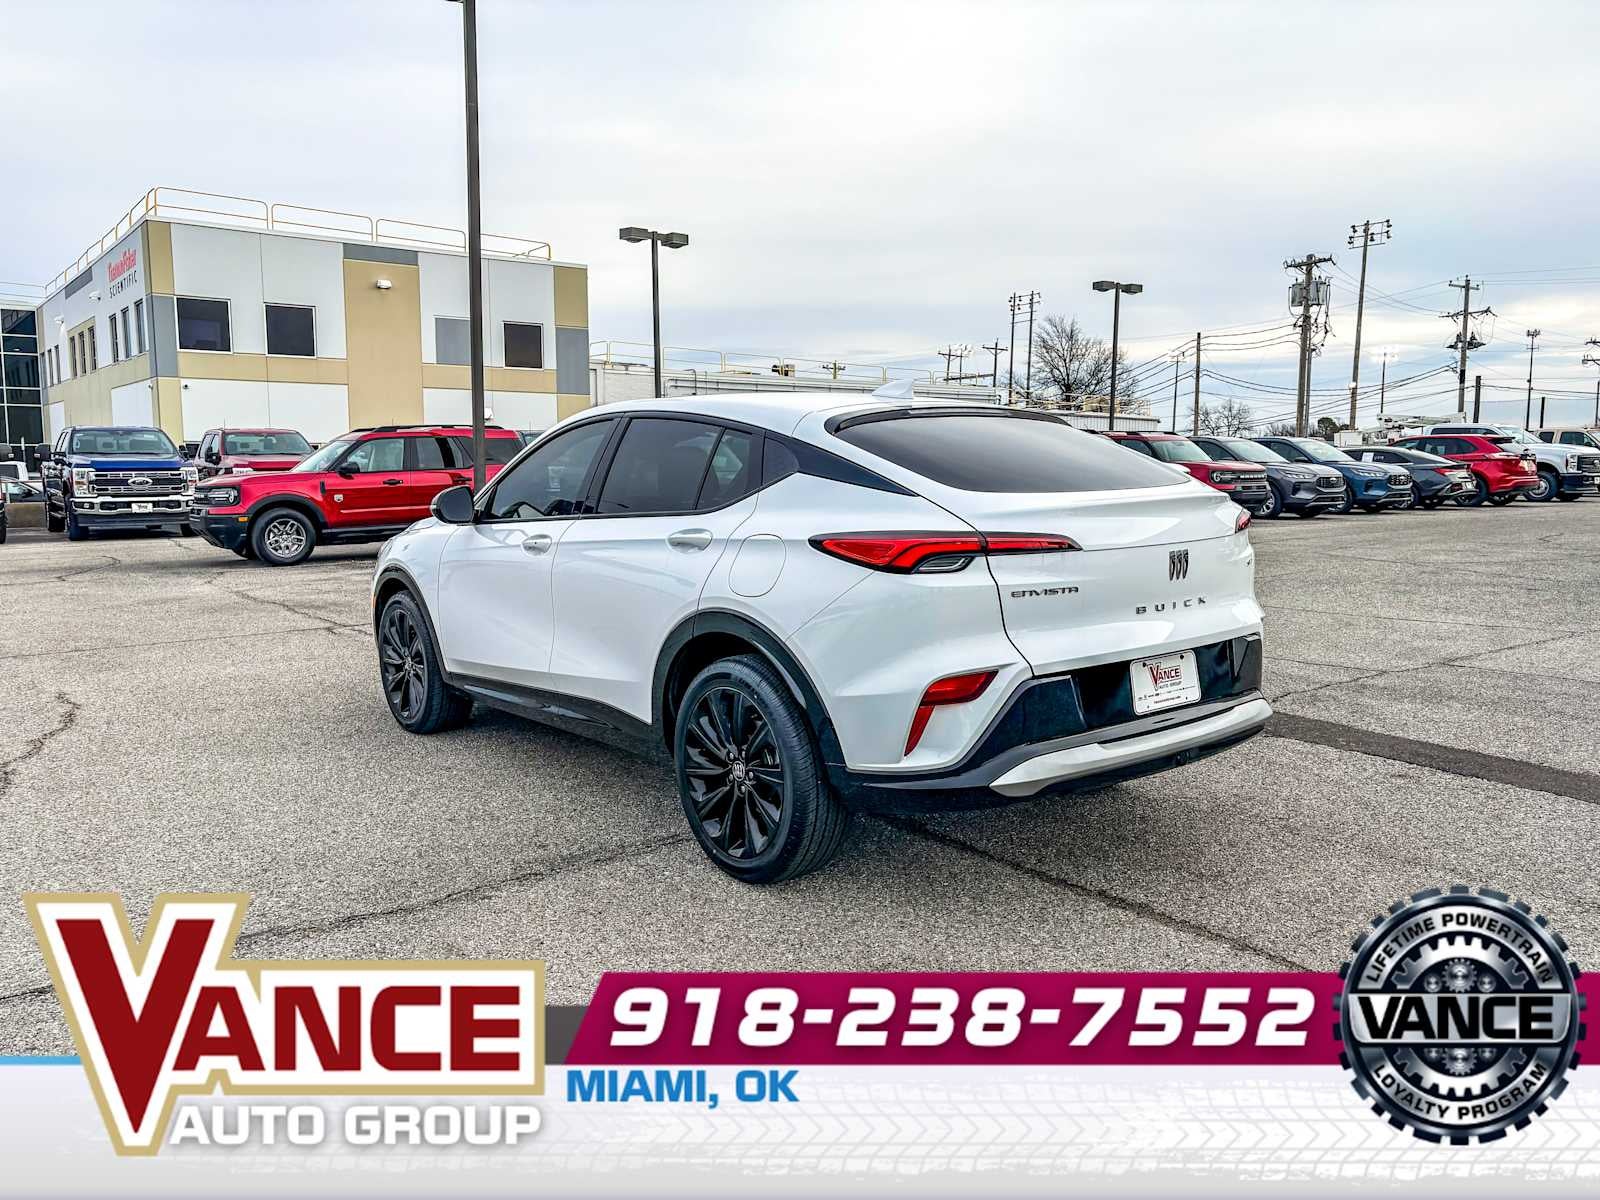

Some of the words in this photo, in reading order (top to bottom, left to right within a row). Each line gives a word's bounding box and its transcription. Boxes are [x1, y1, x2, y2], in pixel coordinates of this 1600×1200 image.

[109, 270, 138, 299] SCIENTIFIC
[1011, 586, 1079, 598] ENVISTA
[1135, 597, 1206, 615] BUICK
